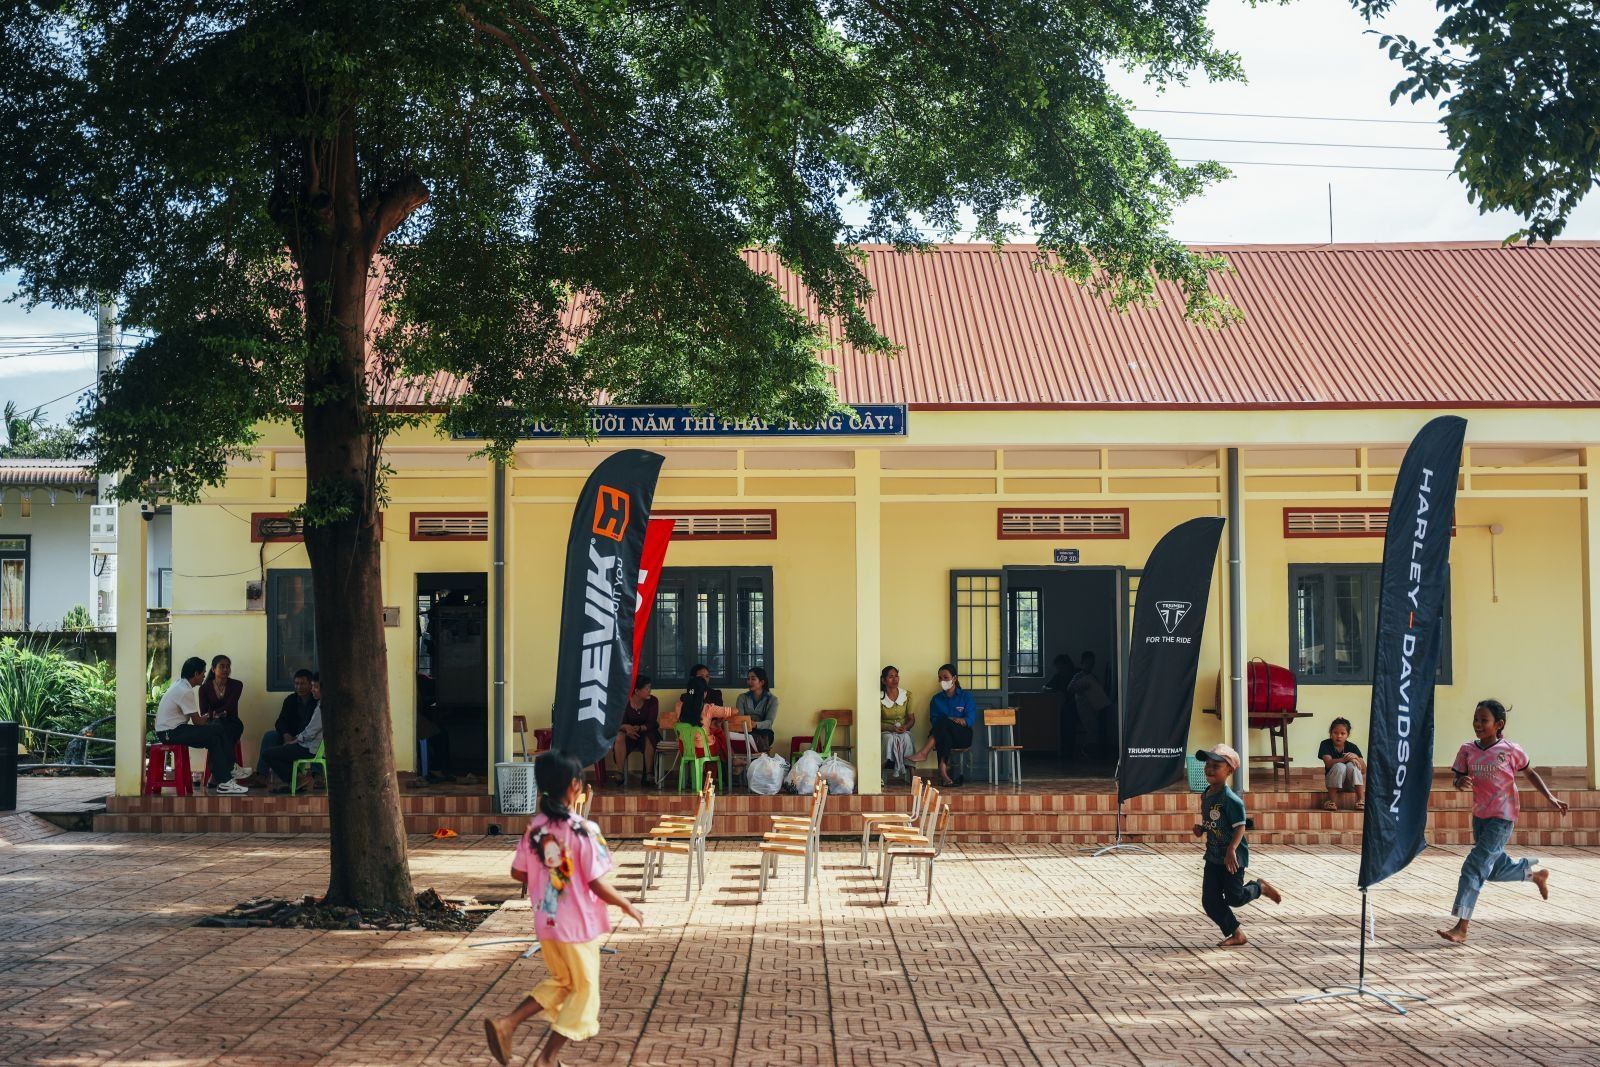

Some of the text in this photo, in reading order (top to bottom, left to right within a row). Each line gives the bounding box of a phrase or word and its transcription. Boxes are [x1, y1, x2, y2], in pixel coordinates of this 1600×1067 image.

[631, 412, 675, 431] NĂM
[681, 412, 716, 431] THÌ
[848, 411, 894, 431] CÂY!
[614, 556, 624, 586] YOU
[1145, 635, 1192, 644] FOR THE RIDE
[1157, 746, 1183, 754] VIETNAM
